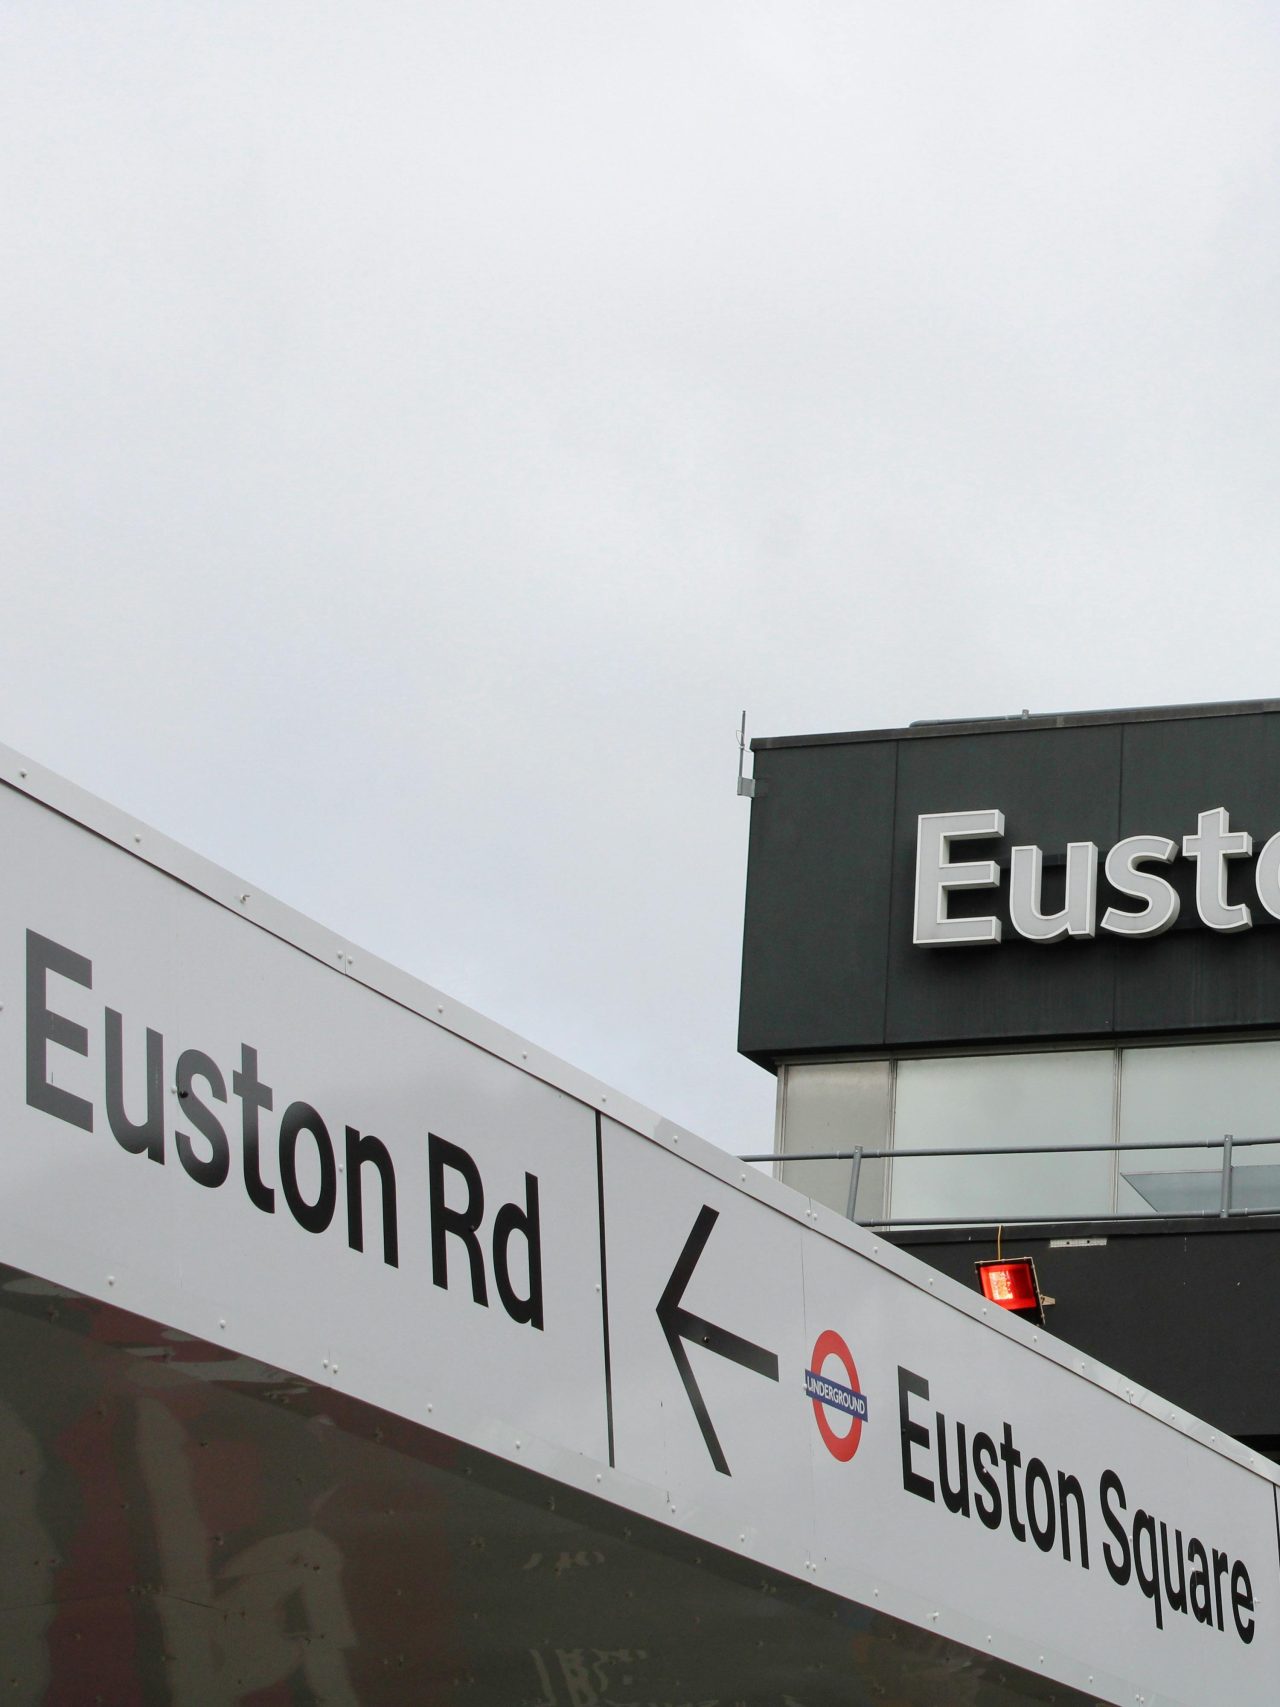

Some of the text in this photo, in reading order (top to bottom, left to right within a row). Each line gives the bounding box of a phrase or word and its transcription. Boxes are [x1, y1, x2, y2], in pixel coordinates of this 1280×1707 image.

[25, 927, 545, 1332] Euston Rd
[806, 1375, 866, 1415] UNDERGROUND
[897, 1364, 1256, 1645] Euston Square
